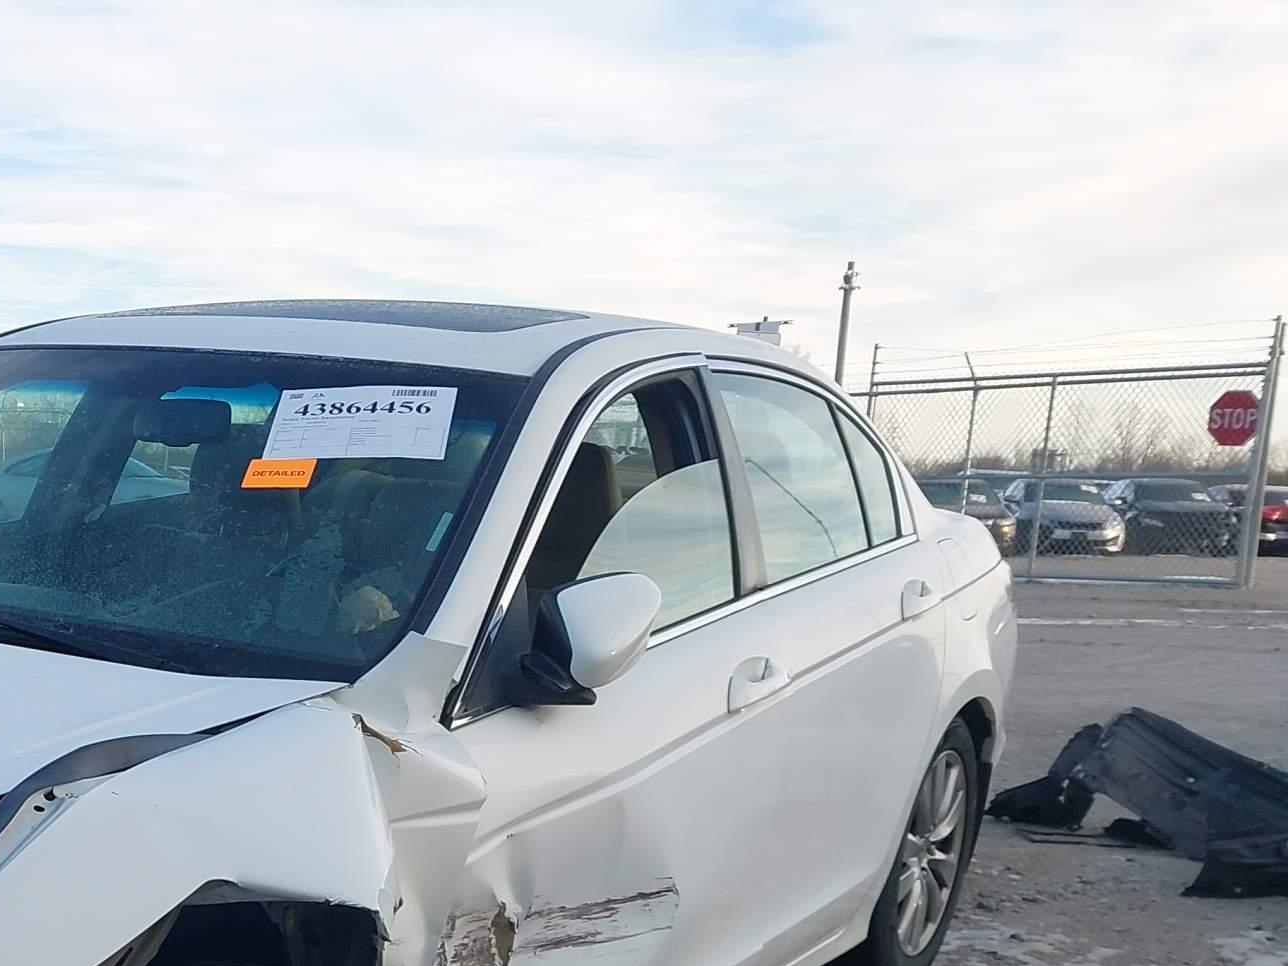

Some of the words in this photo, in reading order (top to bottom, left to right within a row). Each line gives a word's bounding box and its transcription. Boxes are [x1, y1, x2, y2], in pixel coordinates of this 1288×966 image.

[294, 400, 432, 417] 43864456
[1211, 408, 1258, 429] STOP
[252, 470, 306, 478] DETAILED
